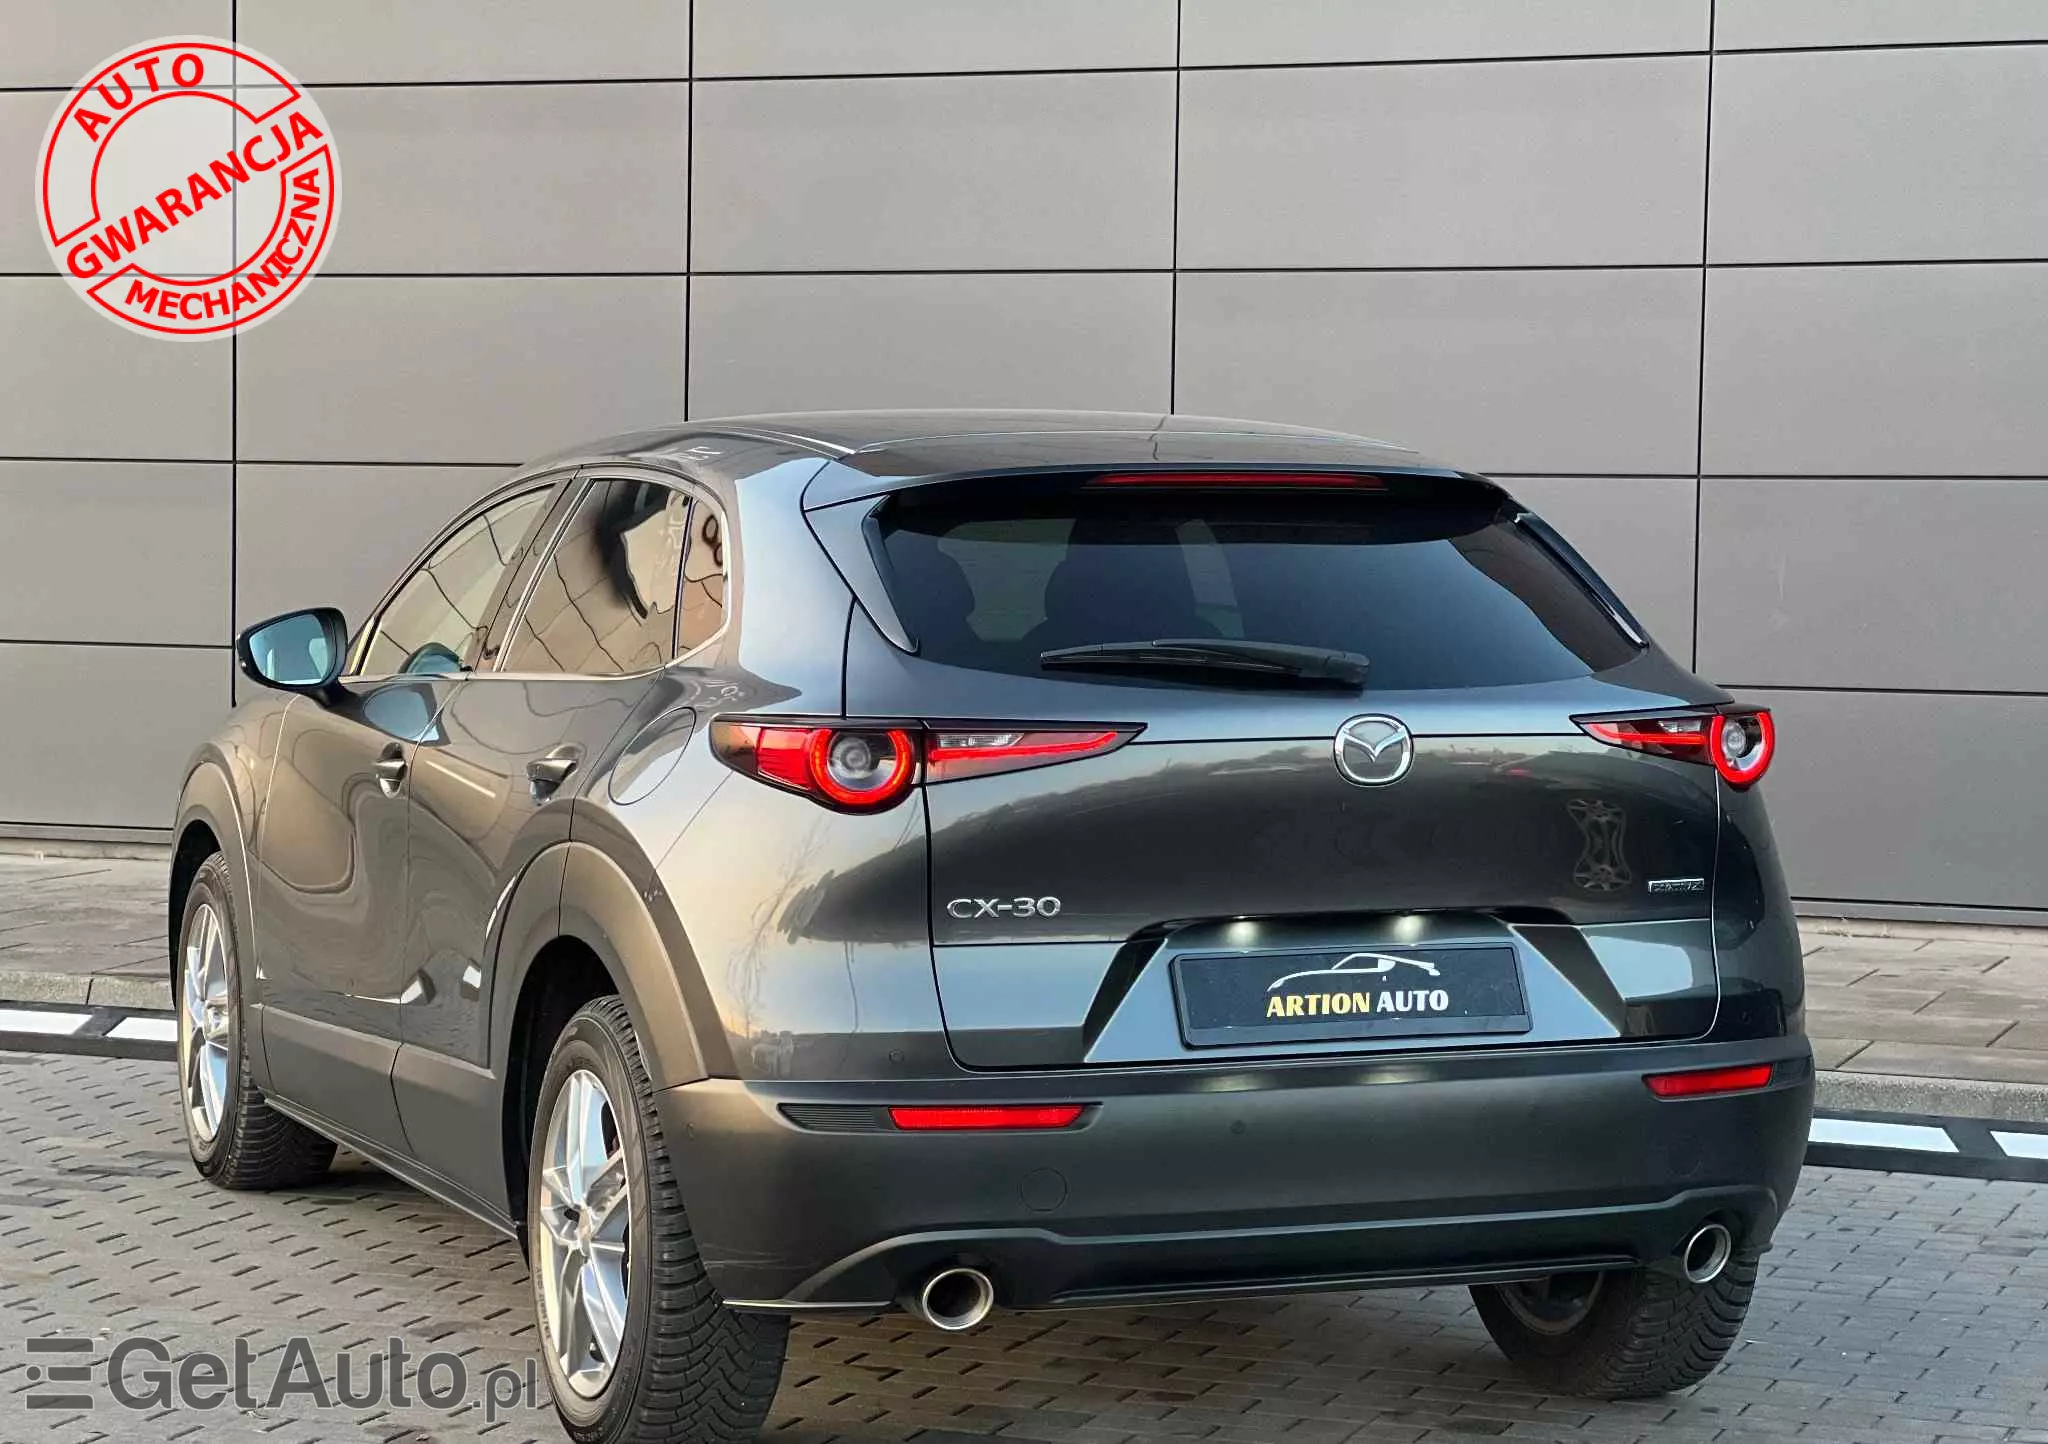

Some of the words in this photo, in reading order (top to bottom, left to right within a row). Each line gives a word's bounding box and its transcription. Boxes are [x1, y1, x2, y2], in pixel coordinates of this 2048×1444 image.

[947, 897, 1060, 918] CX-30
[1266, 992, 1370, 1018] ARTION
[1376, 989, 1449, 1013] AUTO
